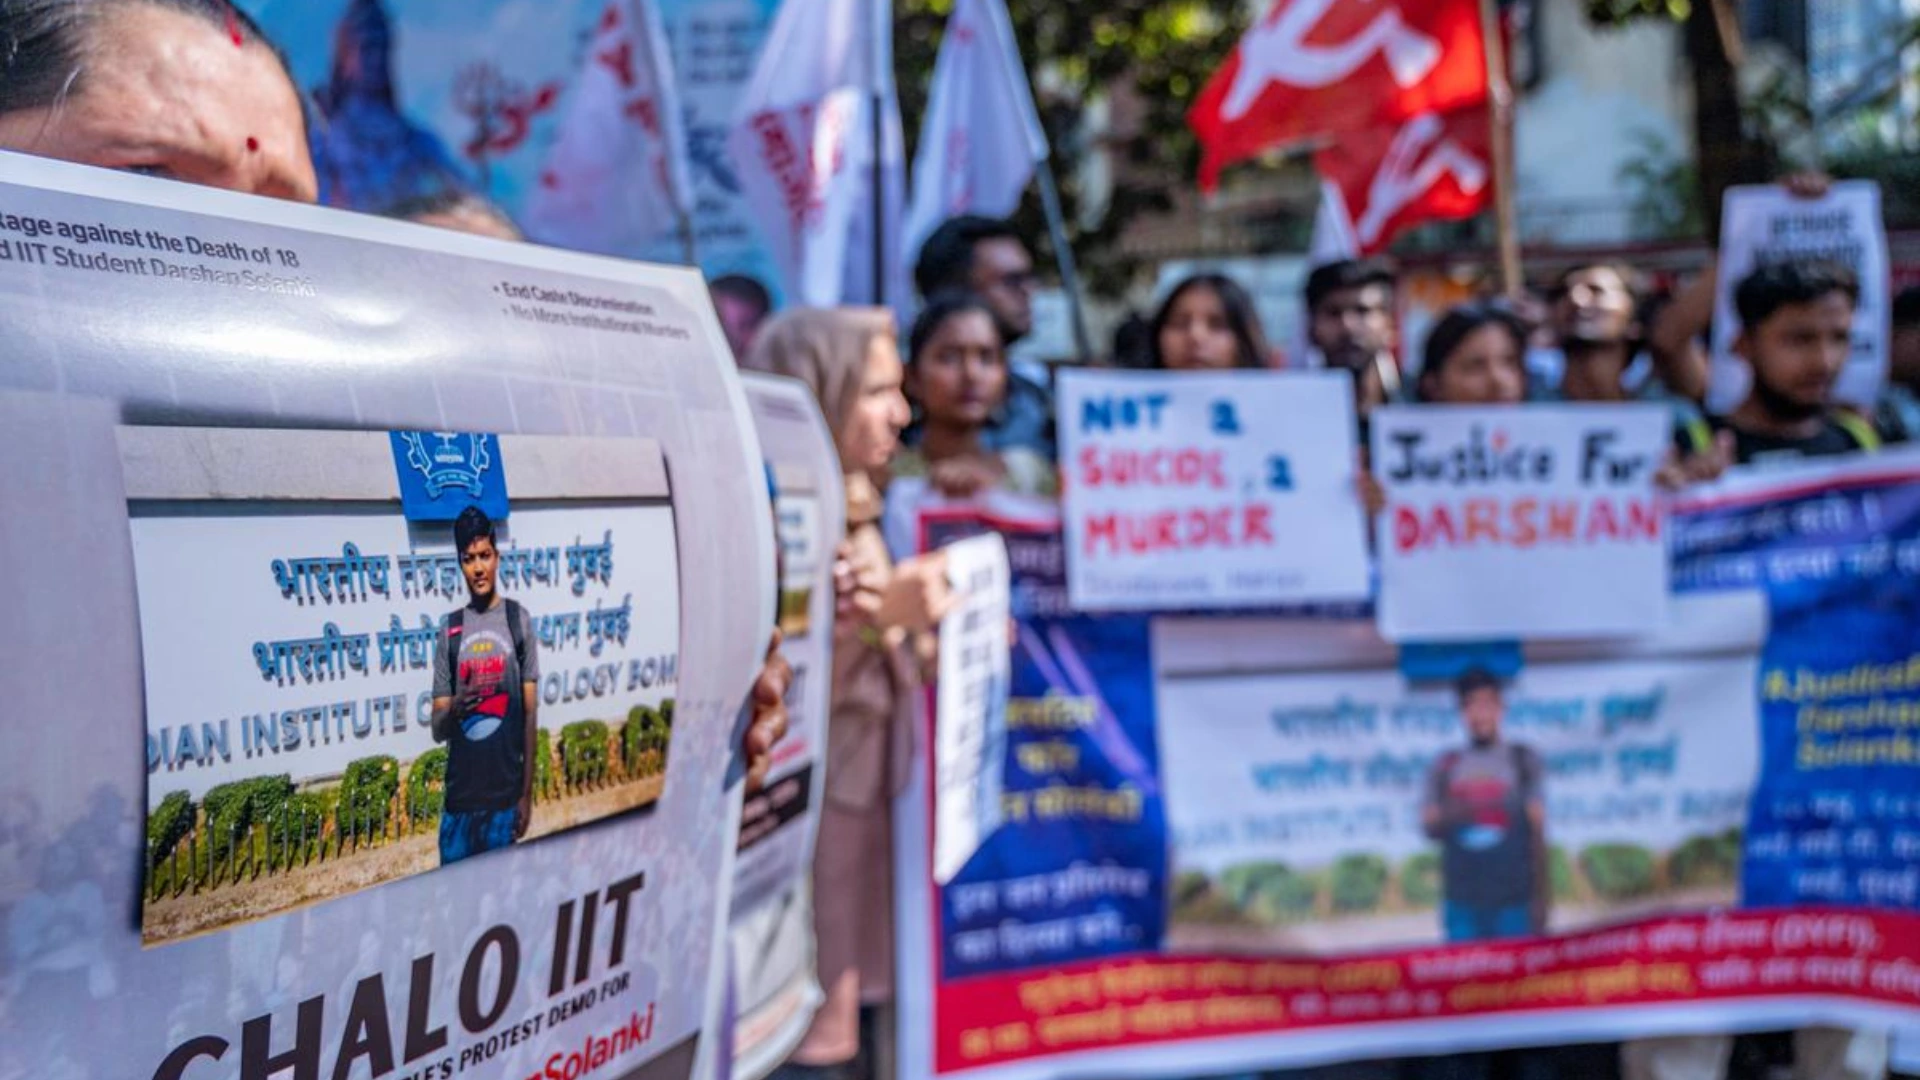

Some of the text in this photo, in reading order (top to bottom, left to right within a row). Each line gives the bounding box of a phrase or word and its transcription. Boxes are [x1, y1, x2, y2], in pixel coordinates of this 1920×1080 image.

[16, 240, 48, 265] IIT
[52, 245, 148, 276] Student
[150, 257, 238, 286] Darshan
[241, 269, 317, 298] Solanki
[57, 221, 145, 247] against
[146, 230, 182, 252] the
[185, 235, 248, 261] Death
[251, 246, 271, 265] of
[276, 249, 300, 269] 18
[502, 281, 531, 300] End
[1081, 392, 1171, 433] NOT
[1388, 424, 1553, 486] Justice
[1085, 503, 1275, 560] MURDER
[1394, 499, 1659, 554] DARSHAN
[271, 541, 391, 606] भारतीय
[566, 528, 613, 597] मुंबई
[252, 621, 370, 687] भारतीय
[585, 592, 632, 657] मुंबई
[241, 693, 408, 758] INSTITUTE
[548, 871, 644, 997] IIT
[459, 1013, 544, 1072] PROTEST
[548, 989, 597, 1028] DEMO
[600, 971, 632, 1003] FOR
